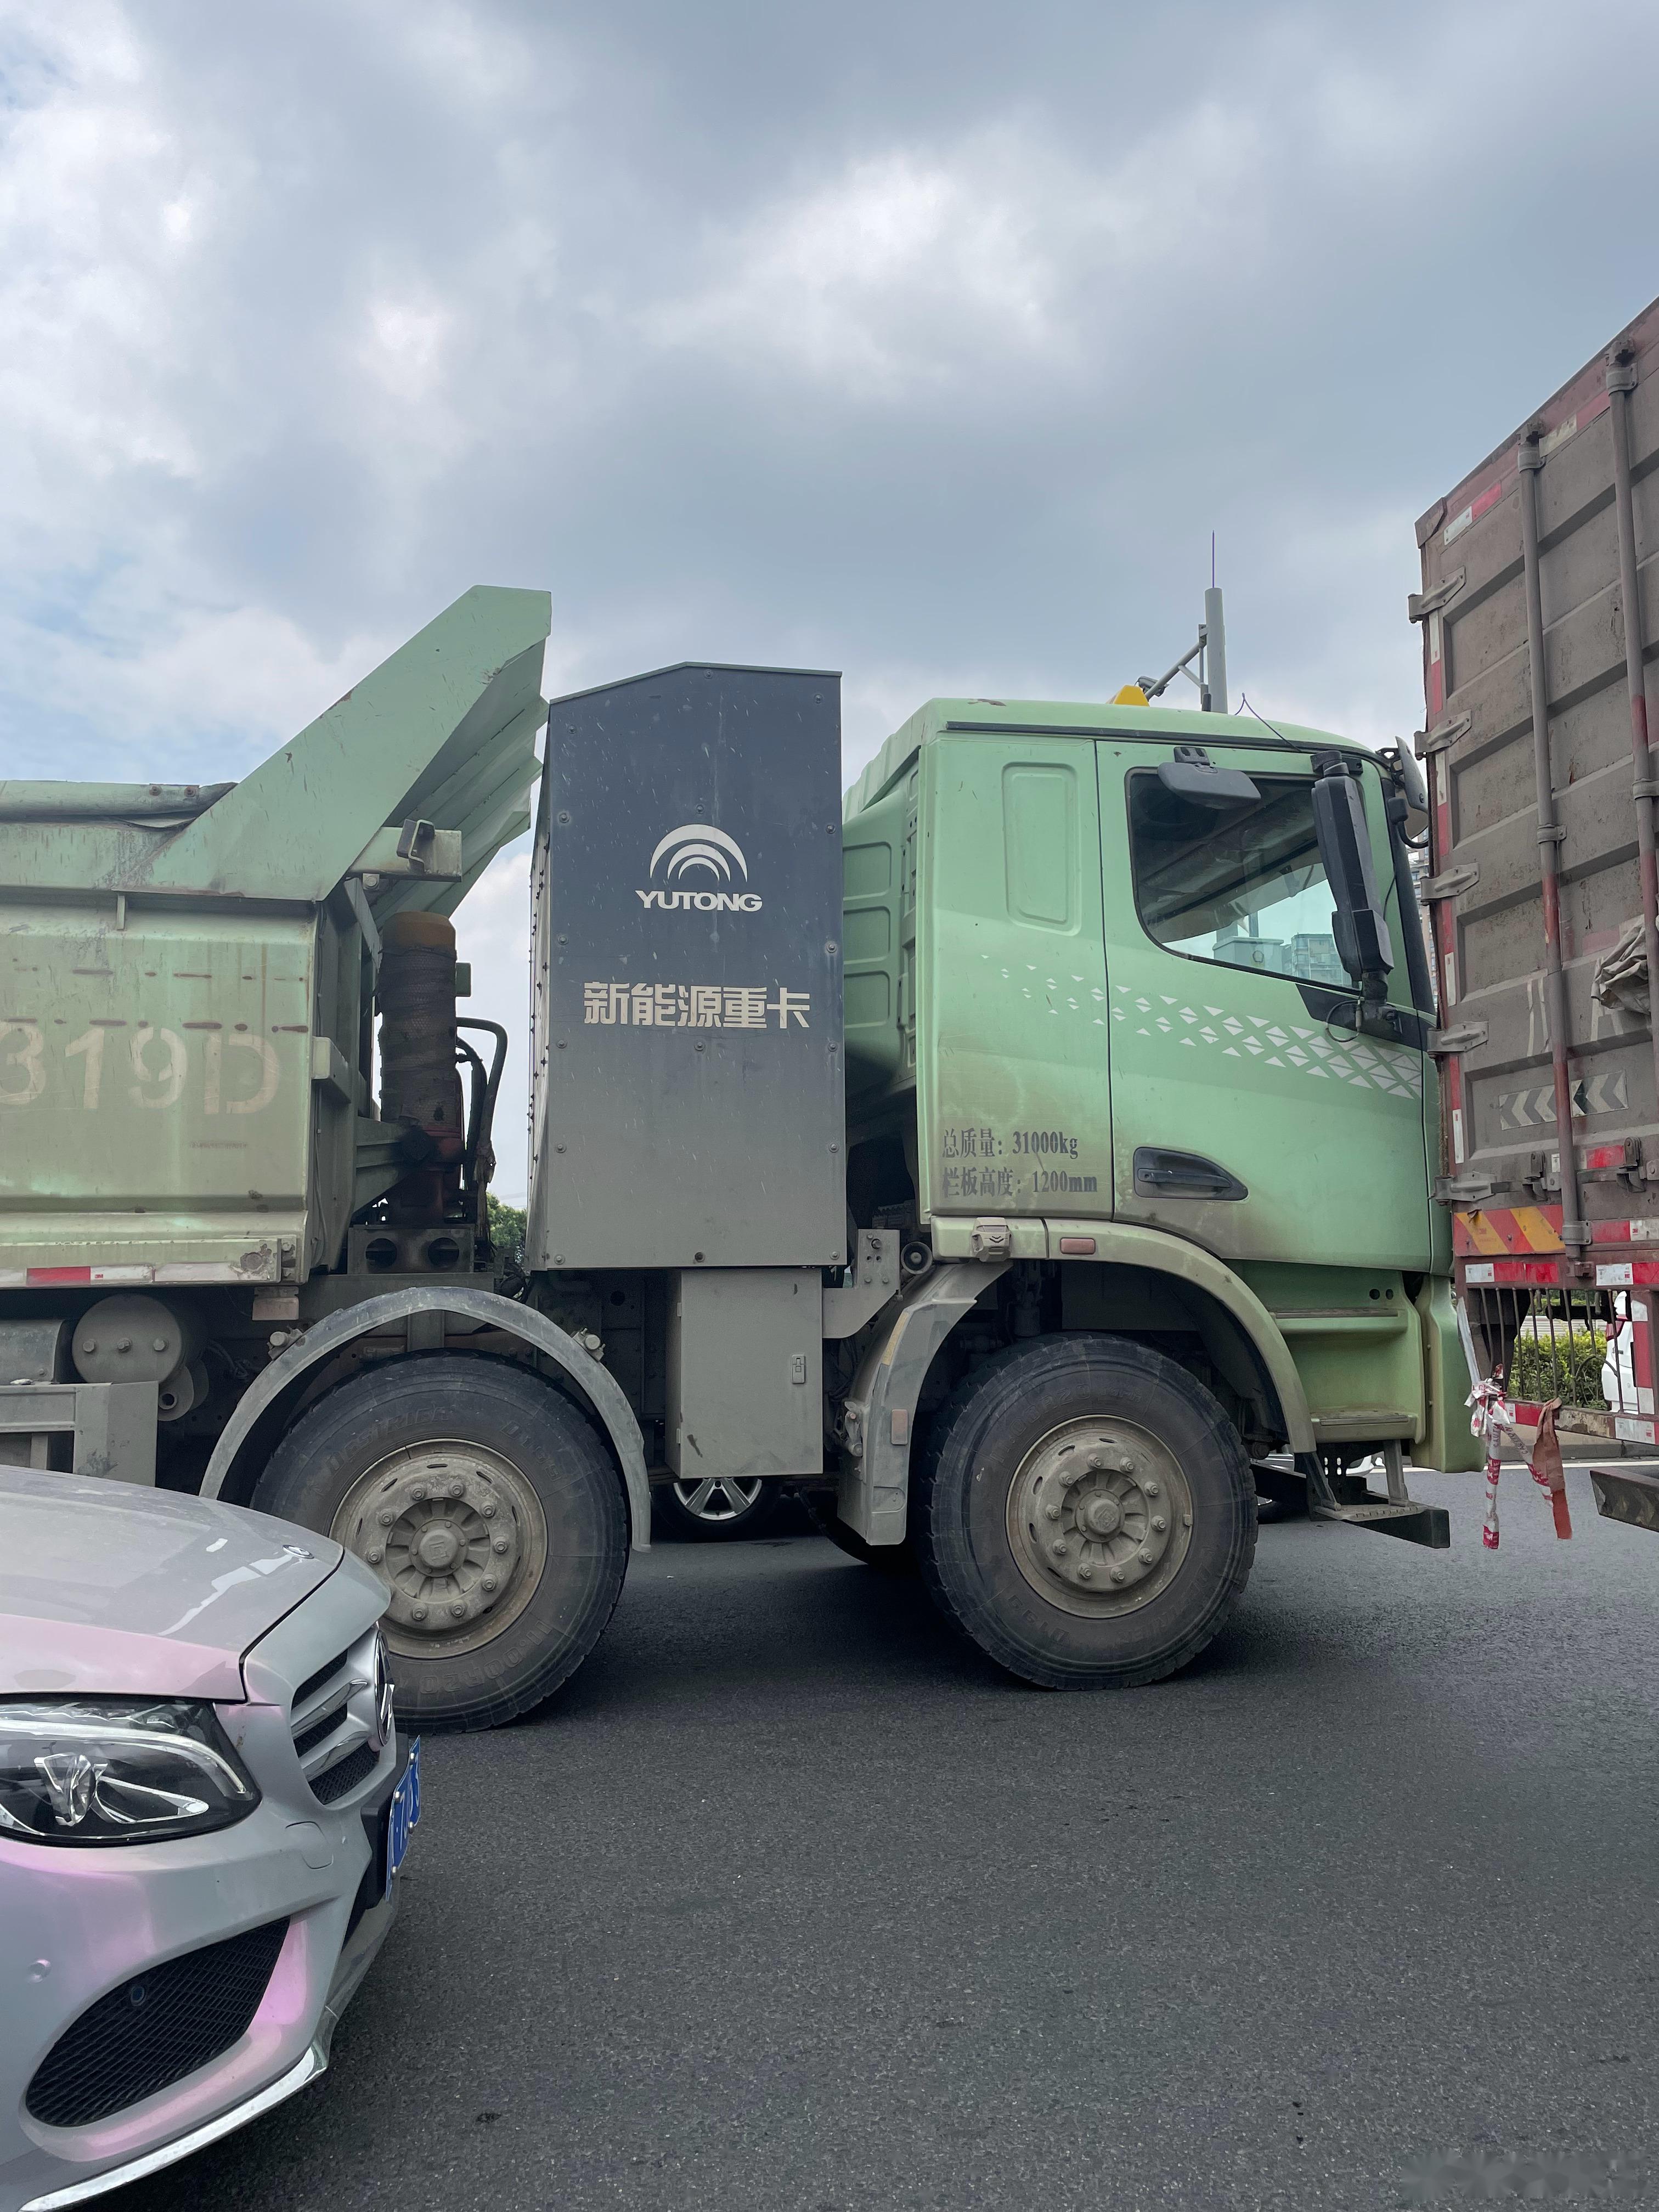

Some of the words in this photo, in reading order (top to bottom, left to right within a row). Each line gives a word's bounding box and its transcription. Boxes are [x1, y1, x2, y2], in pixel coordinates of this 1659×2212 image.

[635, 890, 763, 912] YUTONG
[584, 981, 810, 1029] 新能源重卡
